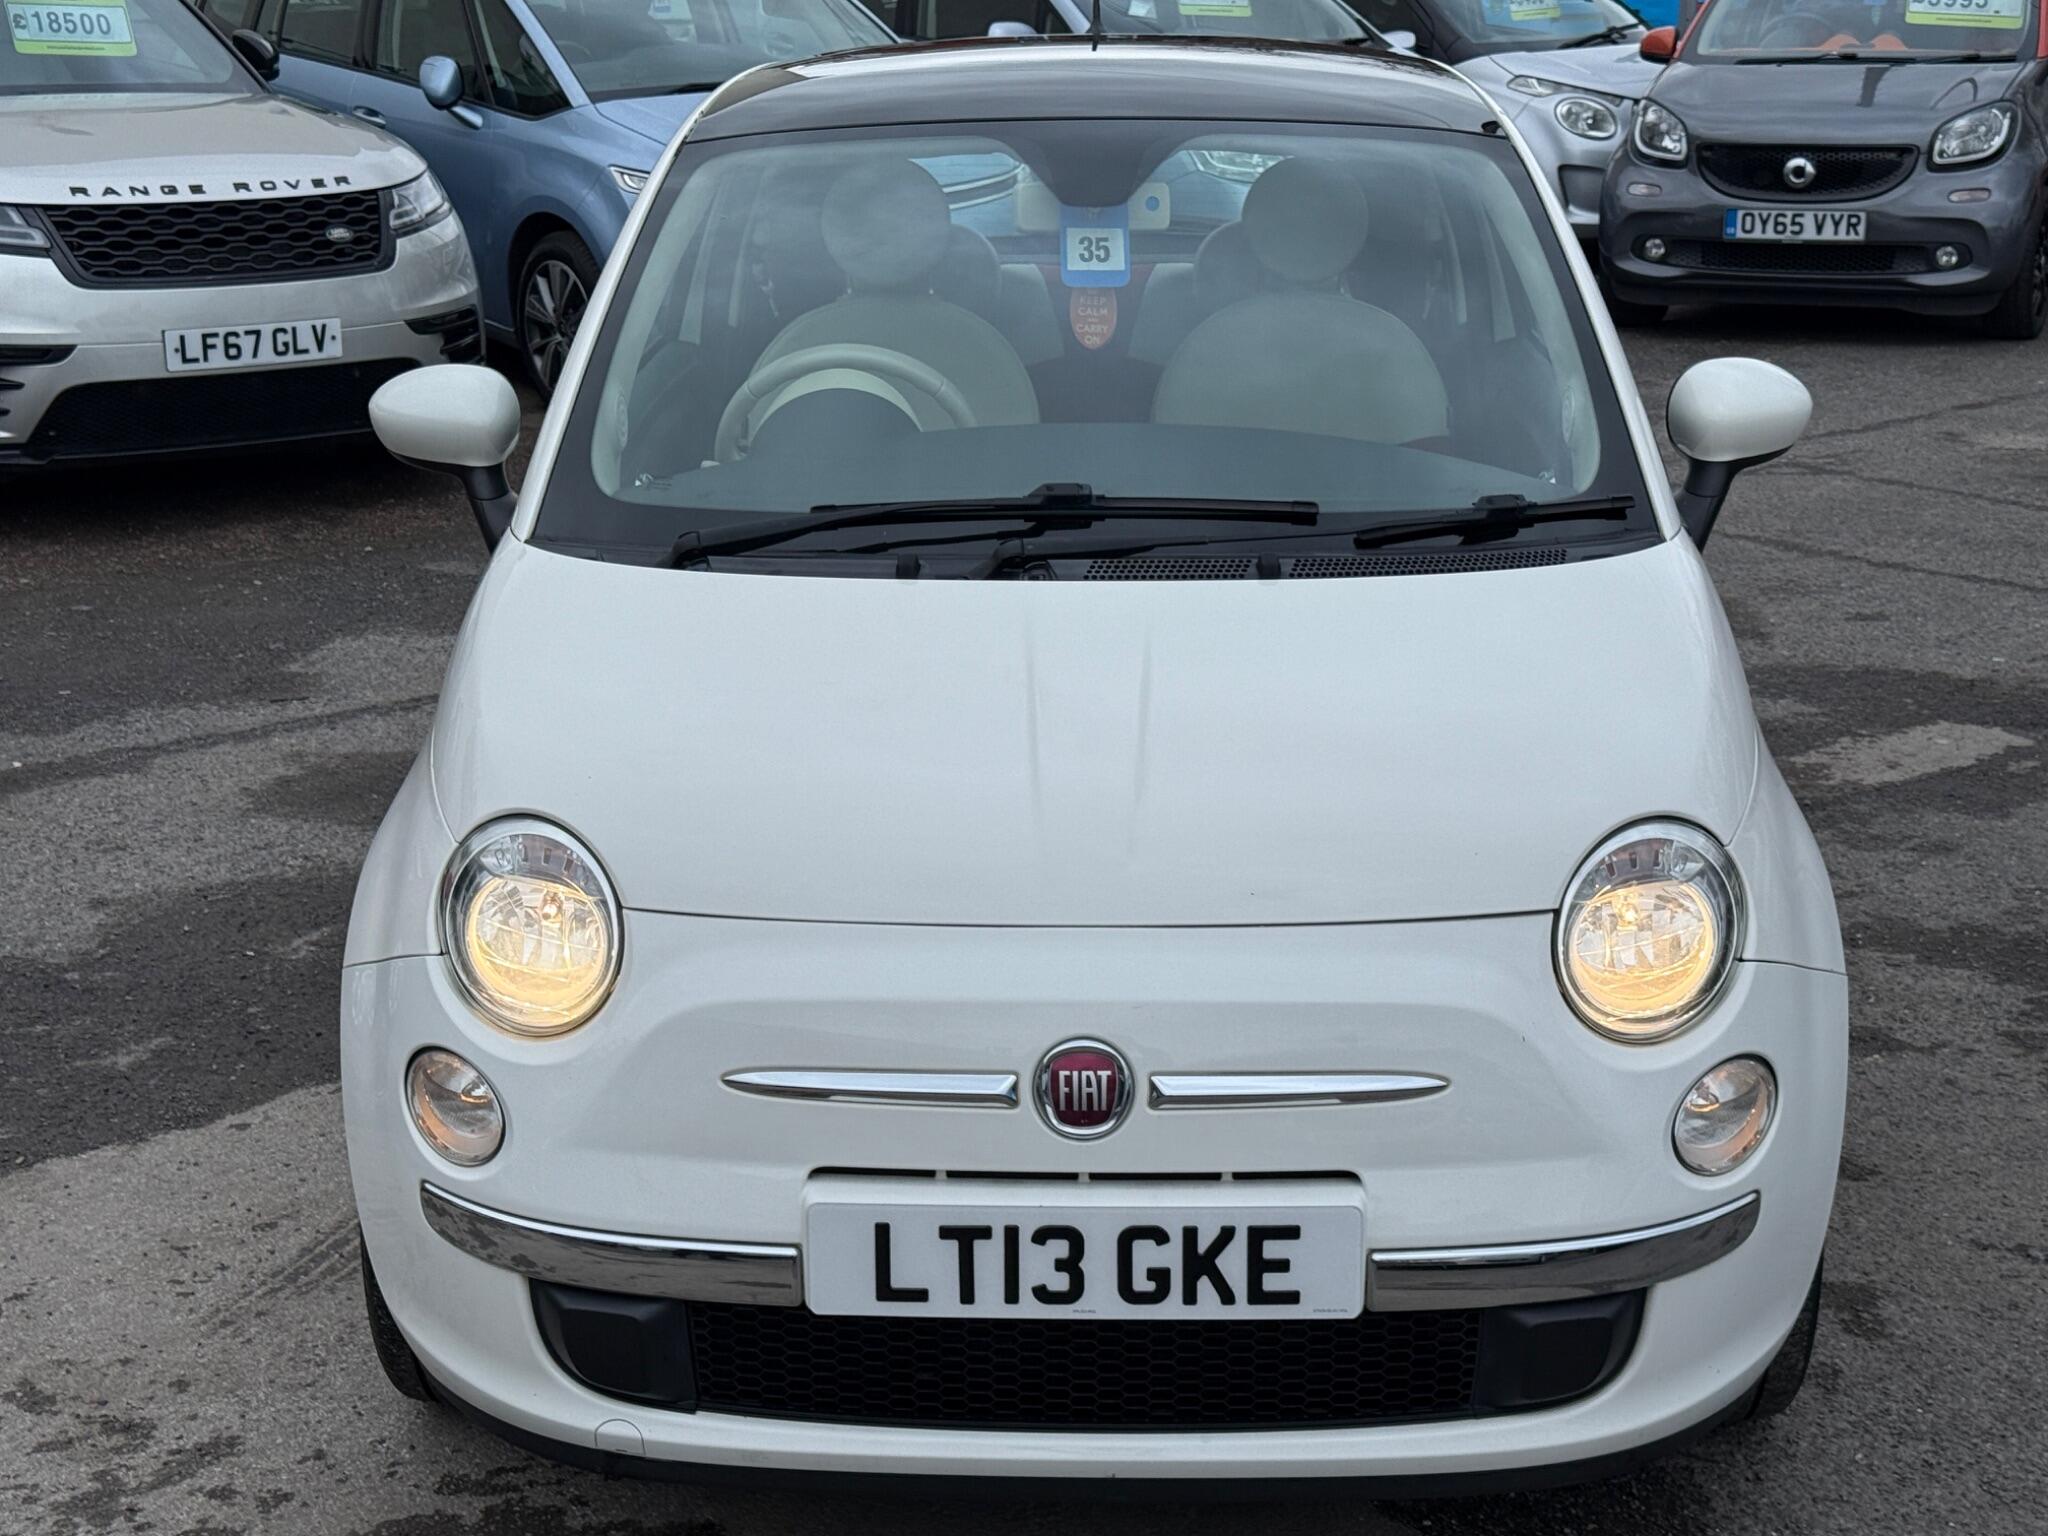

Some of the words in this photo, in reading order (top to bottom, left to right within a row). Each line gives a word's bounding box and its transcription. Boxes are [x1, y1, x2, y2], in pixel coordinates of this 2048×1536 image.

[68, 185, 207, 197] RANGE
[232, 175, 352, 193] ROVER
[1741, 212, 1805, 236] OY65
[1813, 213, 1861, 237] VYR
[1078, 235, 1111, 263] 35
[1078, 306, 1108, 316] CALM
[1080, 295, 1107, 305] KEEP
[1077, 323, 1109, 333] CARRY
[179, 329, 262, 364] LF67
[272, 323, 327, 357] GLV
[1085, 335, 1101, 345] ON
[1058, 1070, 1112, 1112] FIAT
[874, 1222, 1085, 1306] LT13
[1117, 1224, 1301, 1306] GKE
